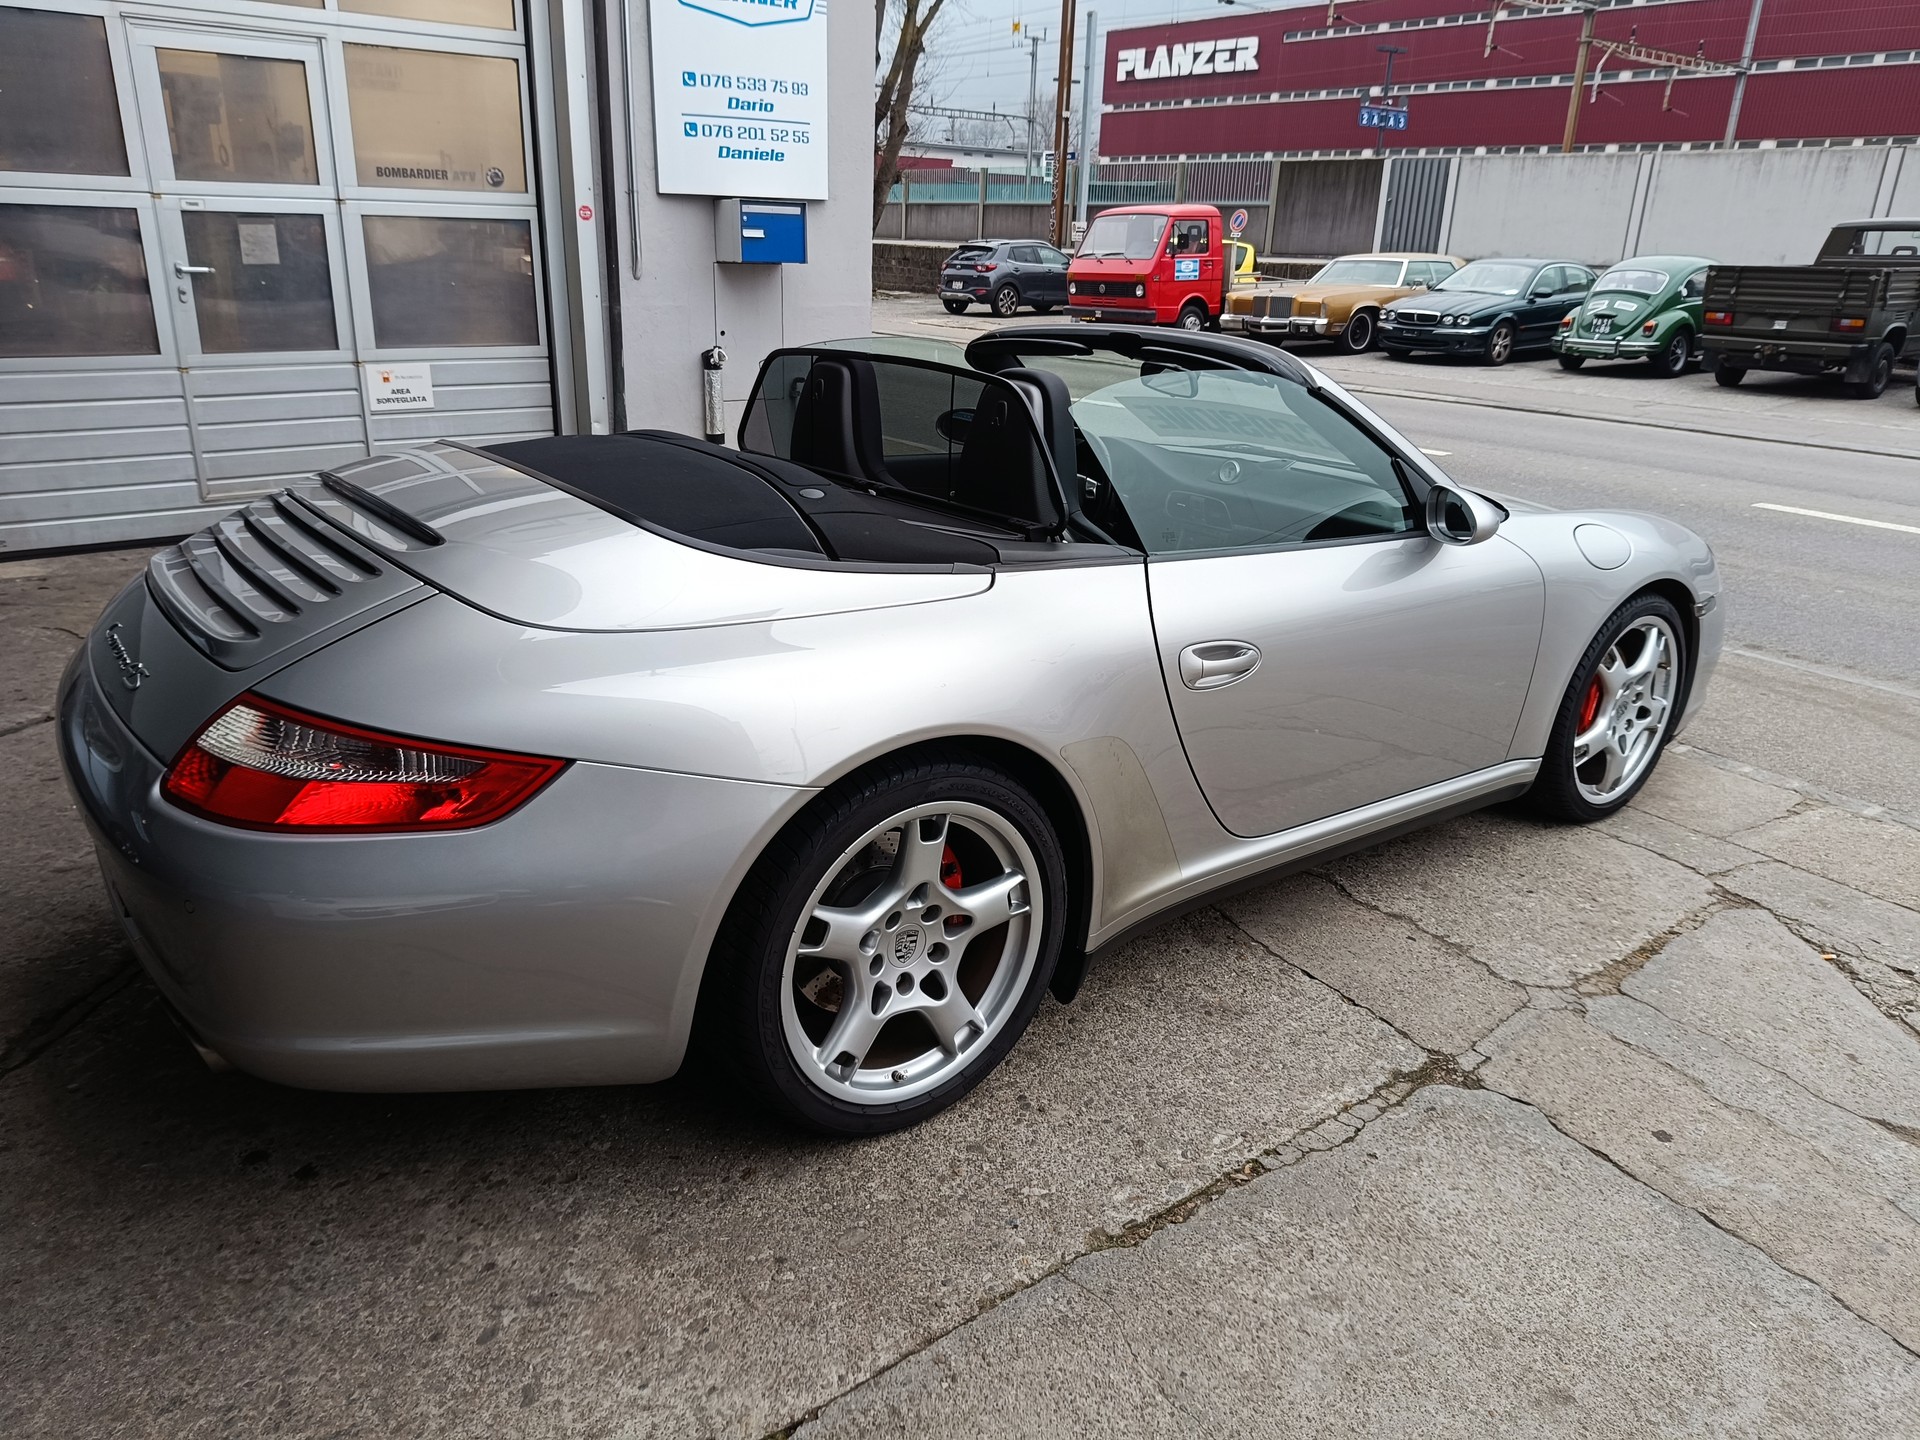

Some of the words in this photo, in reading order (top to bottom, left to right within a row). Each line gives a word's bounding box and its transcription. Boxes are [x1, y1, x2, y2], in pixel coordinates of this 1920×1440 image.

[1116, 36, 1260, 82] PLANZER
[700, 73, 732, 89] 076
[736, 76, 767, 92] 533
[770, 79, 788, 94] 75
[791, 82, 809, 96] 93
[727, 96, 775, 112] Dario
[702, 123, 733, 139] 076
[737, 126, 767, 141] 201
[770, 128, 789, 143] 52
[792, 130, 810, 144] 55
[718, 145, 785, 162] Daniele
[376, 166, 449, 181] BOMBARDIER
